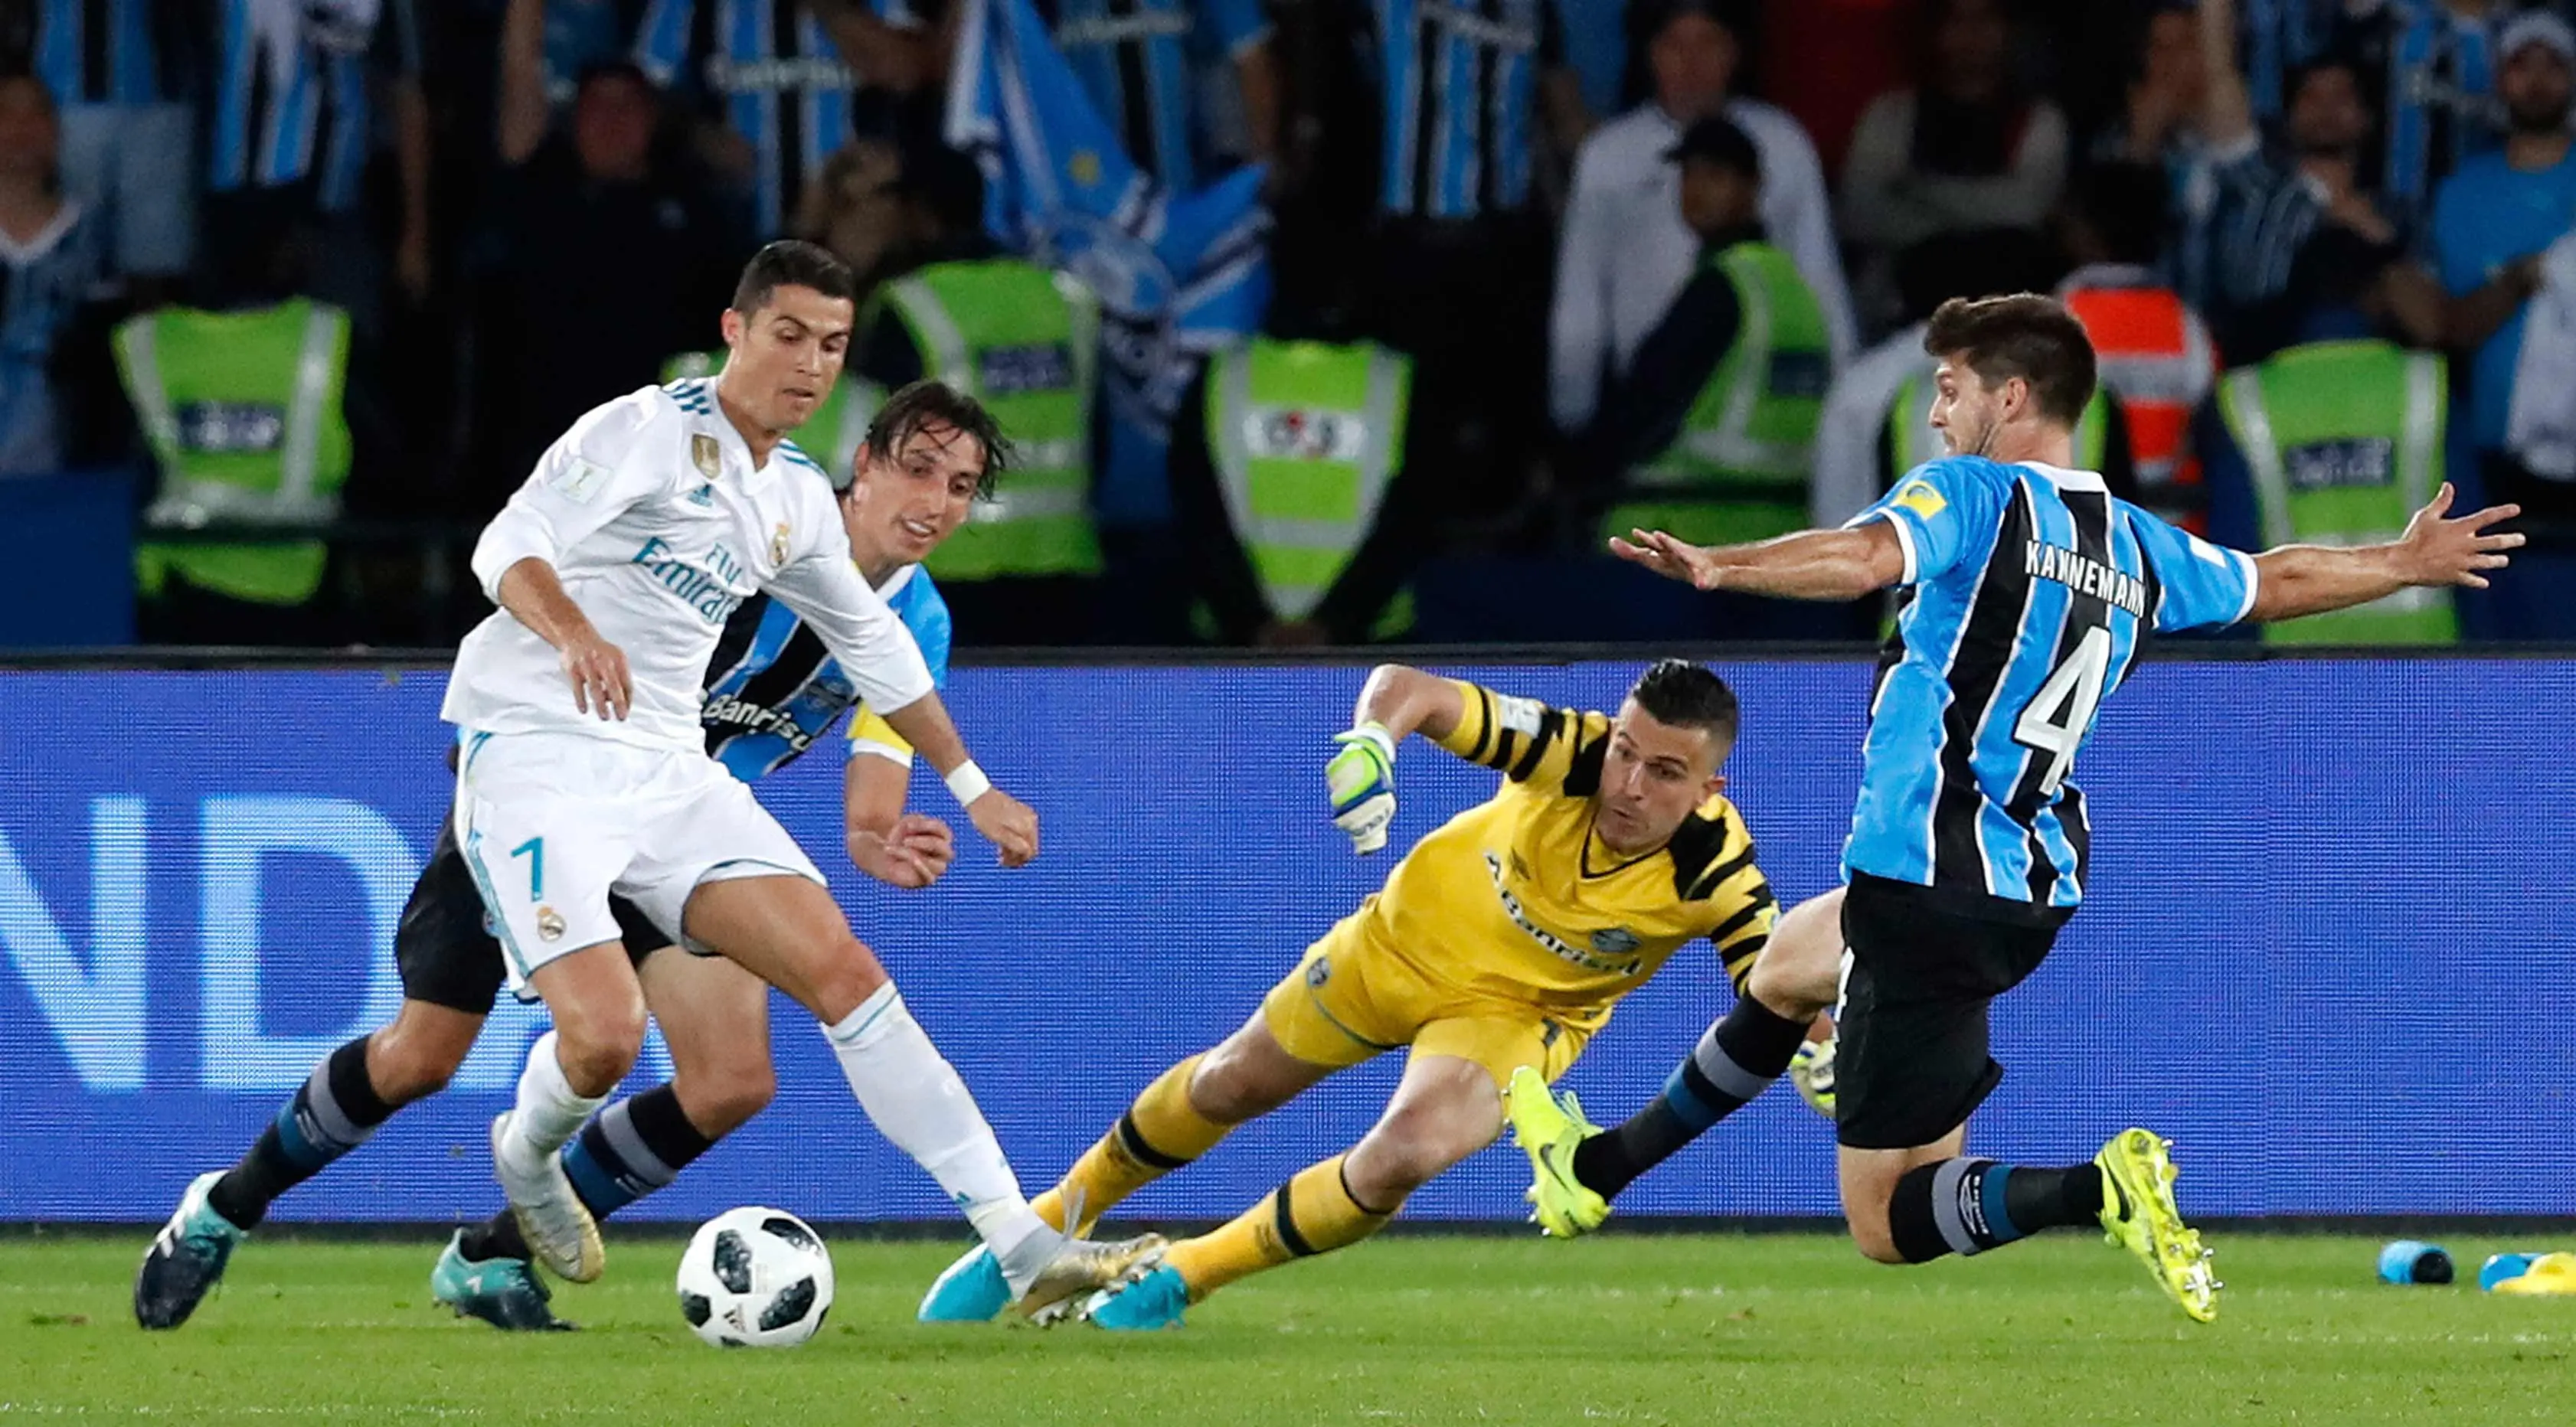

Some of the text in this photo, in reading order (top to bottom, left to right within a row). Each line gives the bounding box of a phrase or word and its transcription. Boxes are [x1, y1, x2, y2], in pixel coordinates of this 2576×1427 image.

[631, 536, 740, 624] Emirat
[704, 542, 743, 586] Fly
[2025, 540, 2144, 619] KANNEMANN
[2013, 625, 2111, 797] 4
